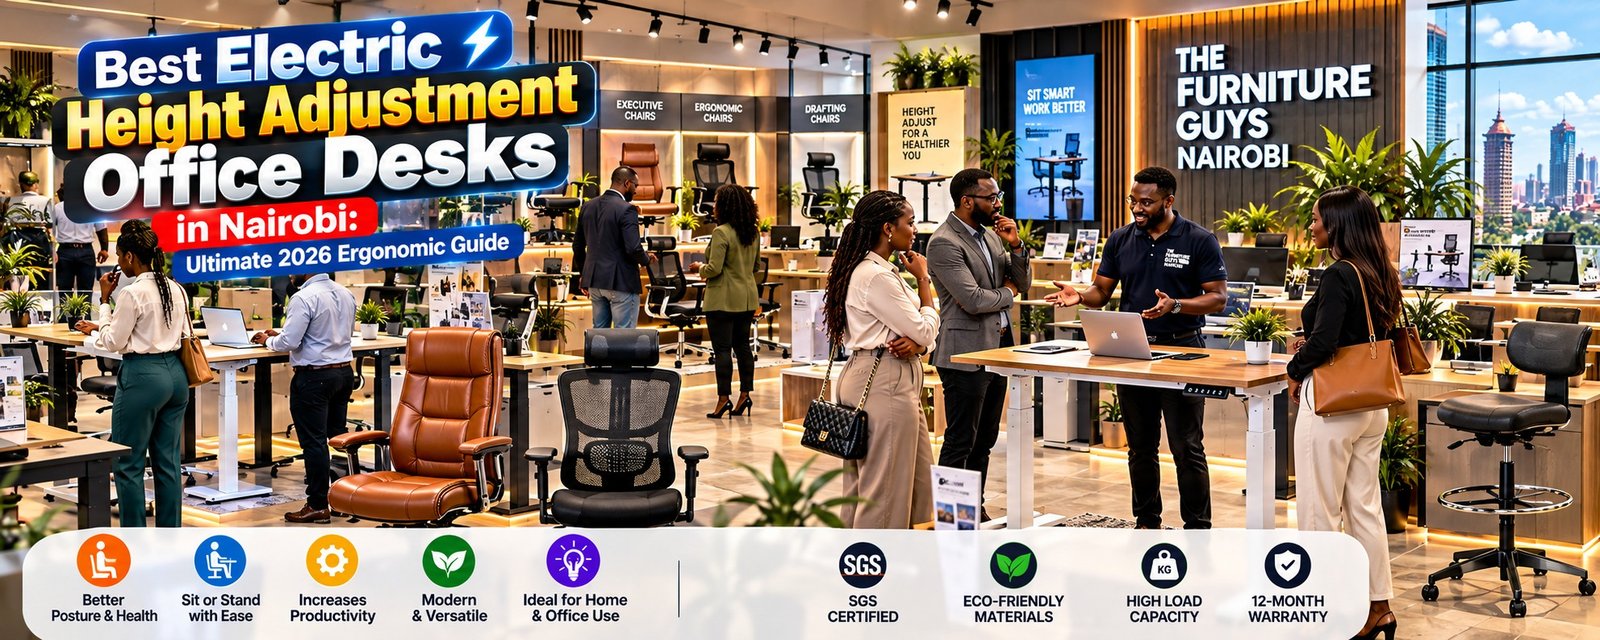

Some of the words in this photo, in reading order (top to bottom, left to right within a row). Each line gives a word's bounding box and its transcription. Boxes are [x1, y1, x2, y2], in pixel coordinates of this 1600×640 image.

[1175, 44, 1225, 73] THE
[1177, 63, 1372, 107] FURNITURE
[1027, 88, 1041, 101] SIT
[1043, 86, 1075, 100] SMART
[616, 100, 664, 111] EXECUTIVE
[694, 102, 743, 113] ERGONOMIC
[804, 104, 847, 114] DRAFTING
[1023, 102, 1050, 115] WORK
[1052, 100, 1086, 114] BETTER
[624, 110, 656, 121] CHAIRS
[902, 106, 936, 117] HEIGHT
[703, 114, 734, 123] CHAIRS
[810, 114, 841, 124] CHAIRS
[902, 118, 937, 127] ADJUST
[1176, 108, 1269, 141] GUYS
[902, 128, 920, 138] FOR
[921, 128, 928, 138] A
[902, 138, 950, 149] HEALTHIER
[902, 150, 921, 160] YOU
[1177, 143, 1289, 170] NAIROBI
